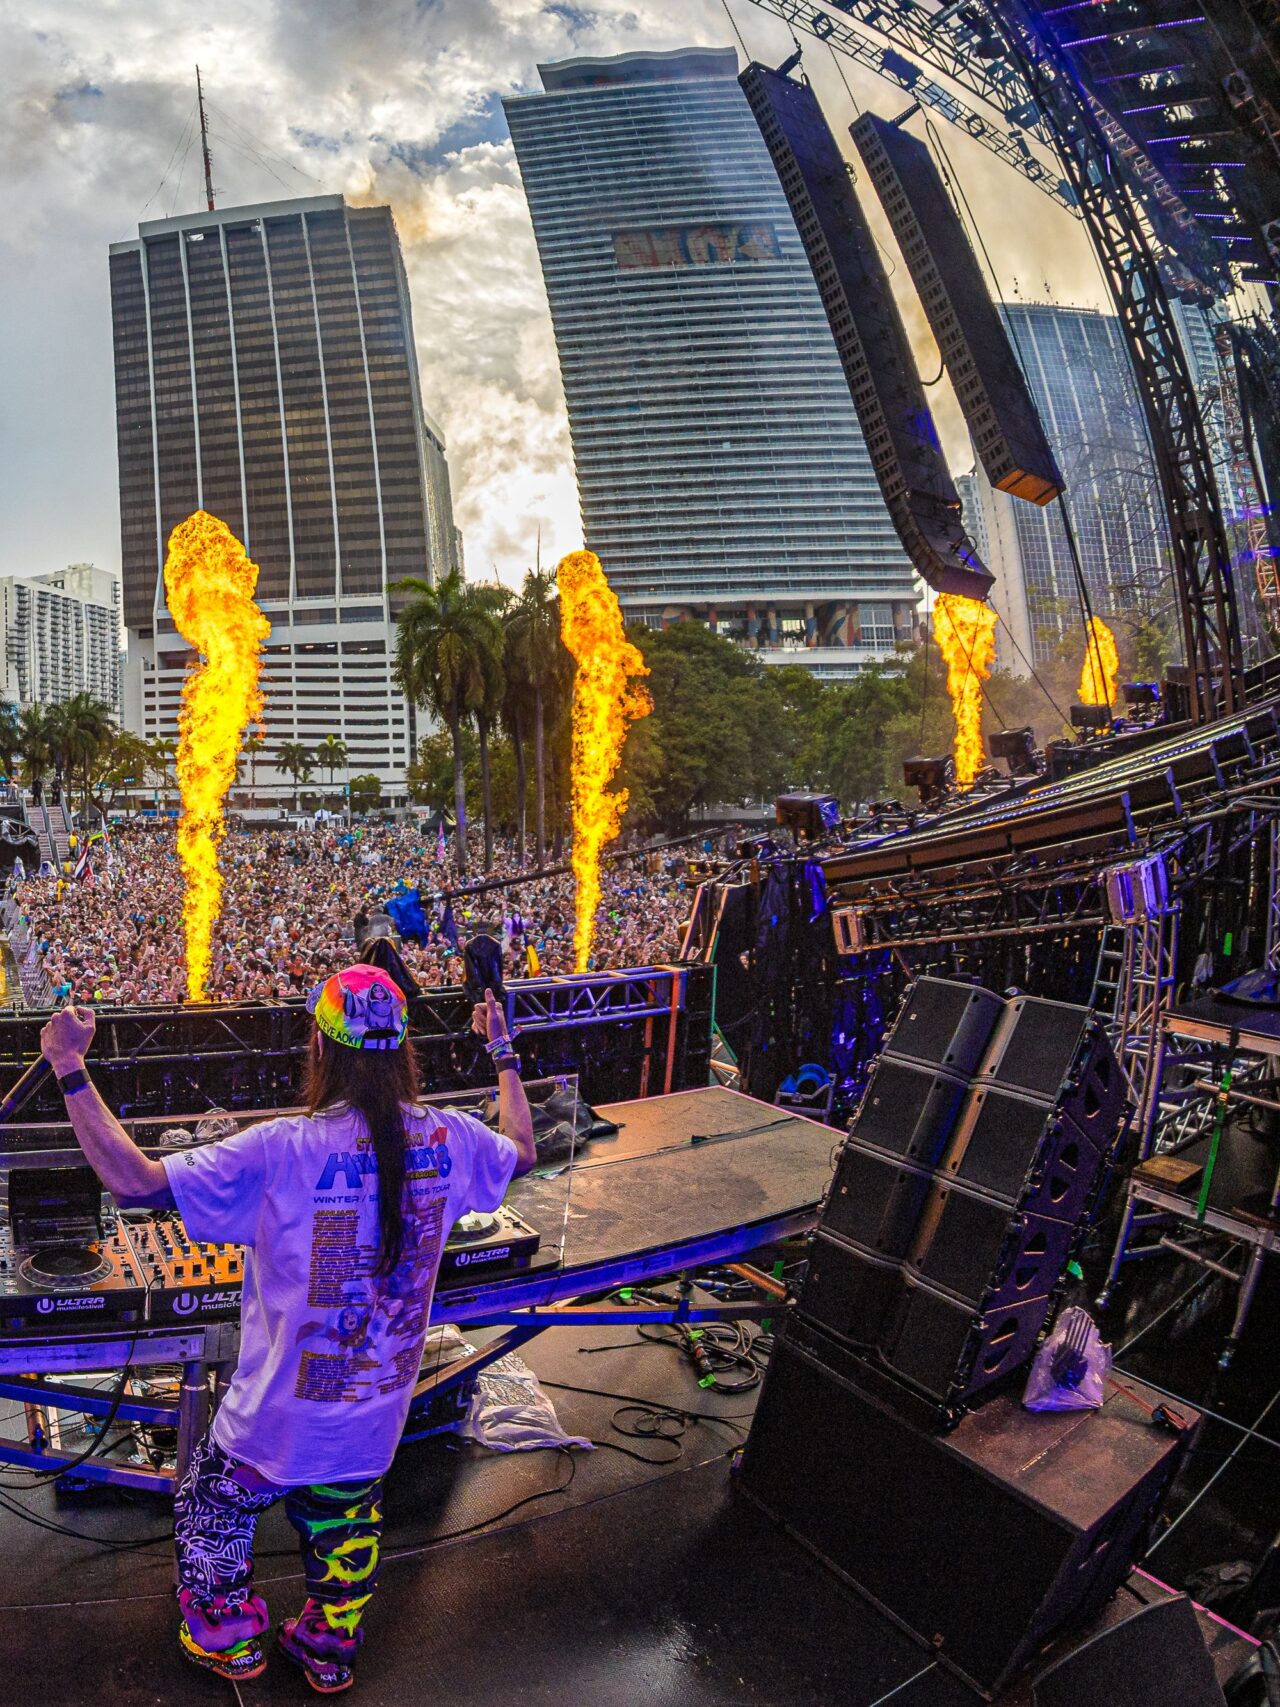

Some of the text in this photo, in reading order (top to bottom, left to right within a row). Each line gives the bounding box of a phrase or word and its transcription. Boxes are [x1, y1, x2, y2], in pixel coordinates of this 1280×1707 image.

[336, 1031, 359, 1047] AOKI
[313, 1195, 360, 1203] WINTER
[431, 1183, 451, 1195] TOUR
[472, 1247, 510, 1259] ULTRA
[56, 1297, 105, 1306] ULTRA
[201, 1290, 241, 1303] ULT
